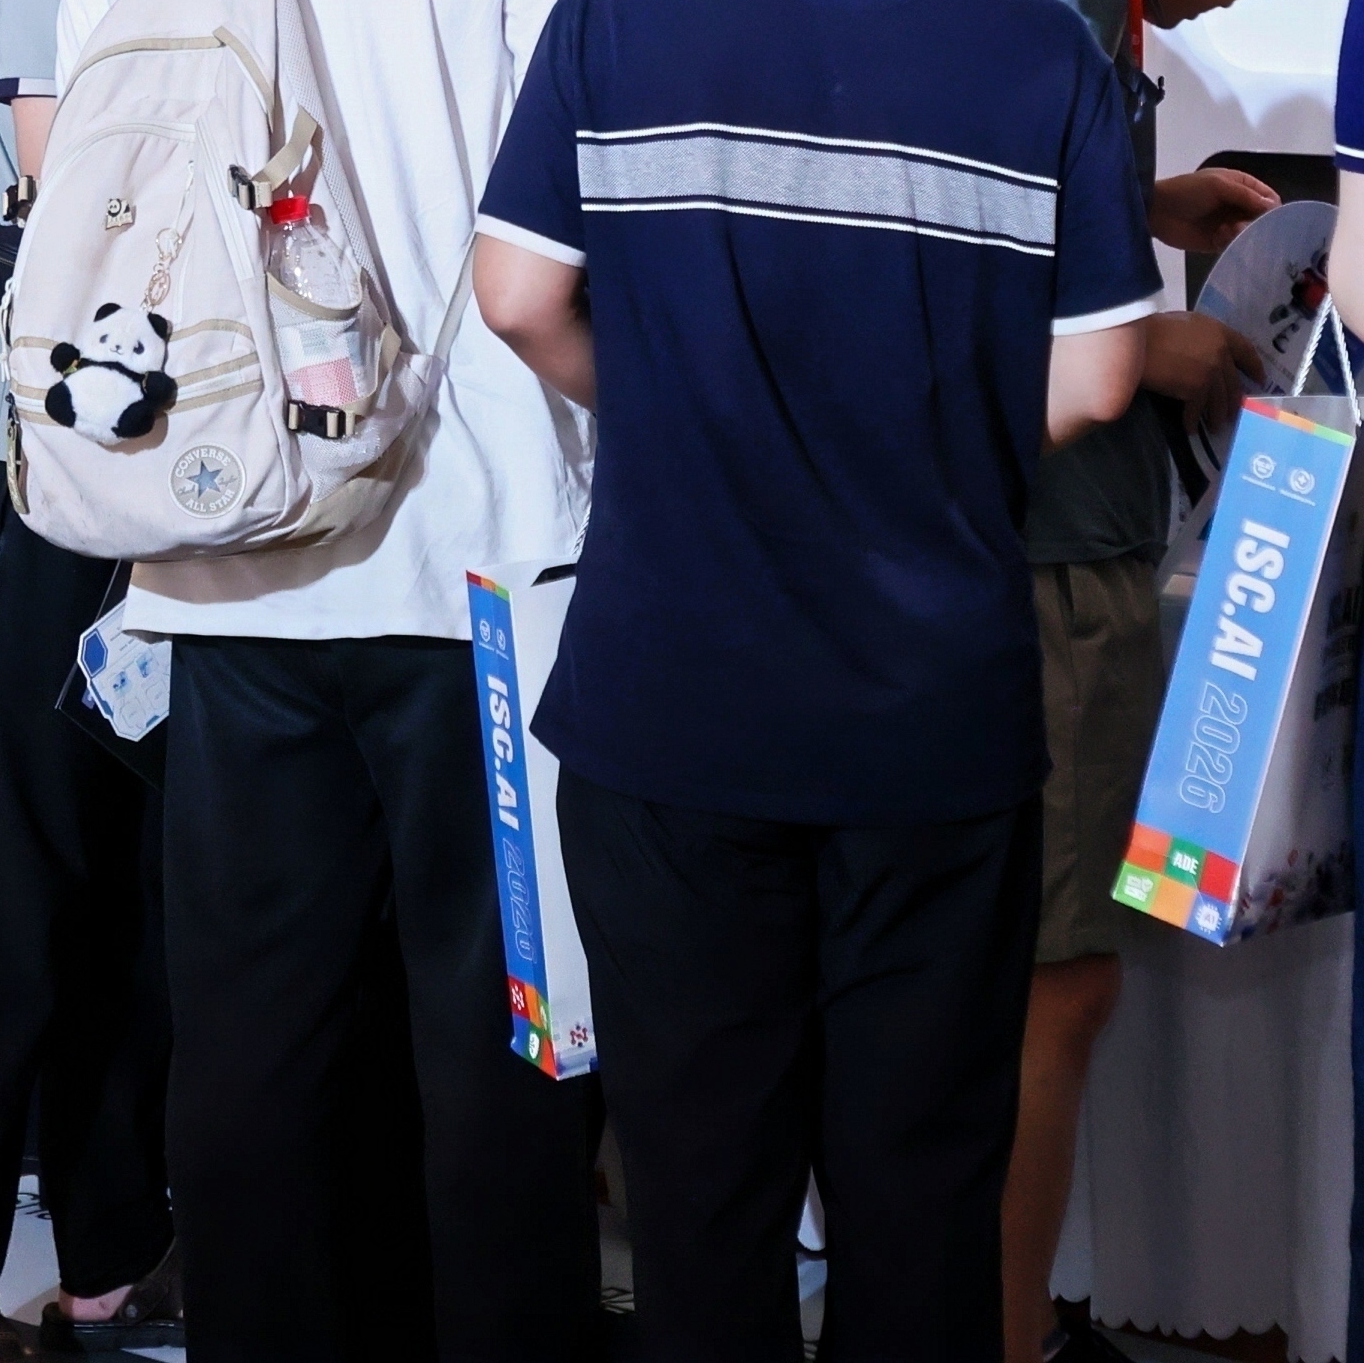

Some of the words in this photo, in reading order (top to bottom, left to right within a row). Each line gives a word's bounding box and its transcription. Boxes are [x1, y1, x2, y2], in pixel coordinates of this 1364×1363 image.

[175, 448, 231, 478] CONVERSE
[185, 498, 207, 513] ALL
[209, 489, 236, 512] STAR
[1209, 520, 1291, 682] ISC.AI
[487, 673, 522, 832] ISC.AI
[1180, 683, 1249, 815] 2026
